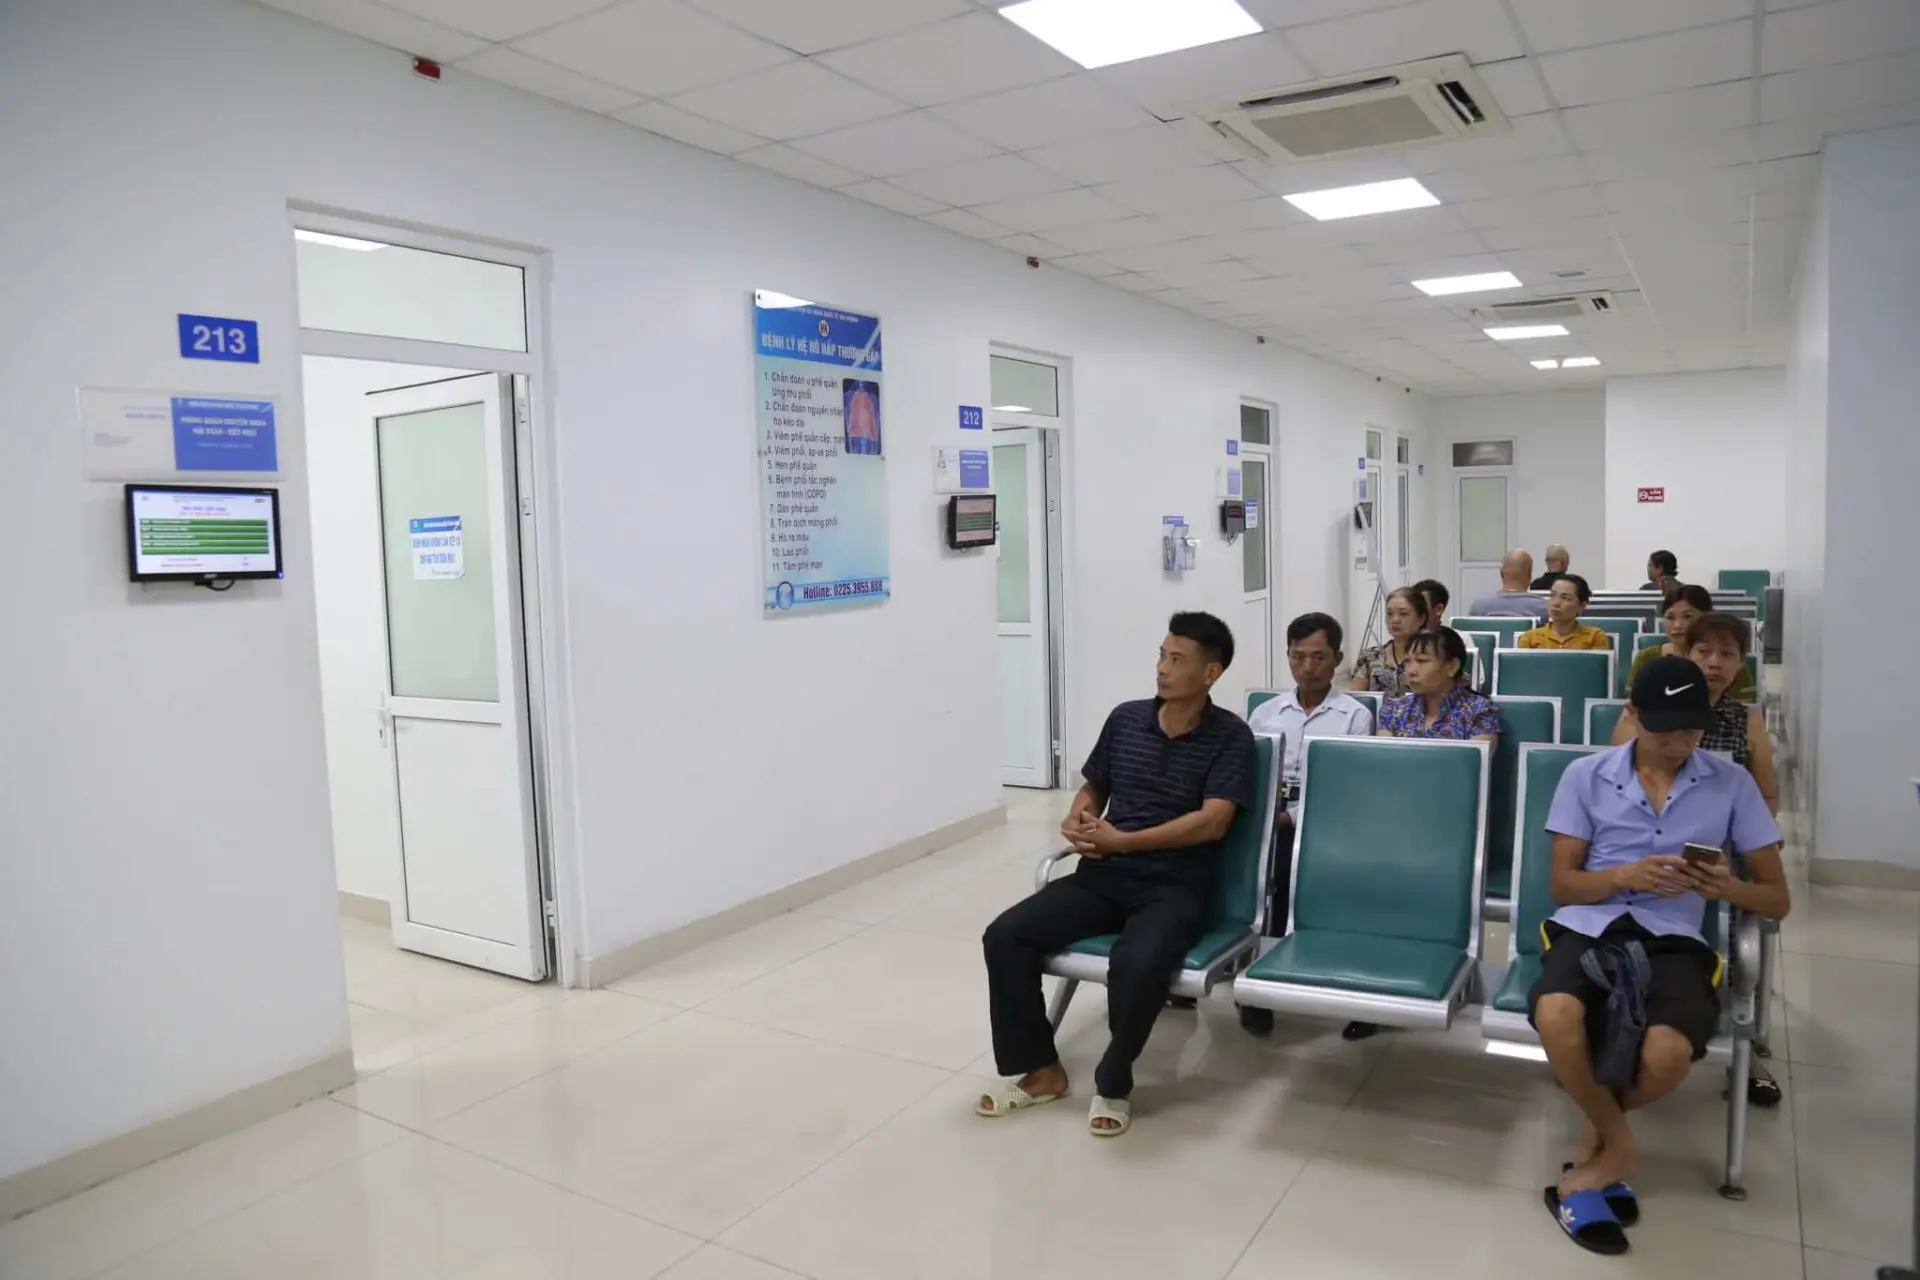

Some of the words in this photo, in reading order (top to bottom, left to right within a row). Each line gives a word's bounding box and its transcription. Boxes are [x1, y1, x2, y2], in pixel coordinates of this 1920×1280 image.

[192, 324, 247, 354] 213
[761, 331, 784, 350] BỆNH
[786, 335, 796, 350] LÝ
[963, 410, 980, 425] 212
[803, 585, 832, 600] Hotline:
[833, 579, 883, 597] 0225.3955.888
